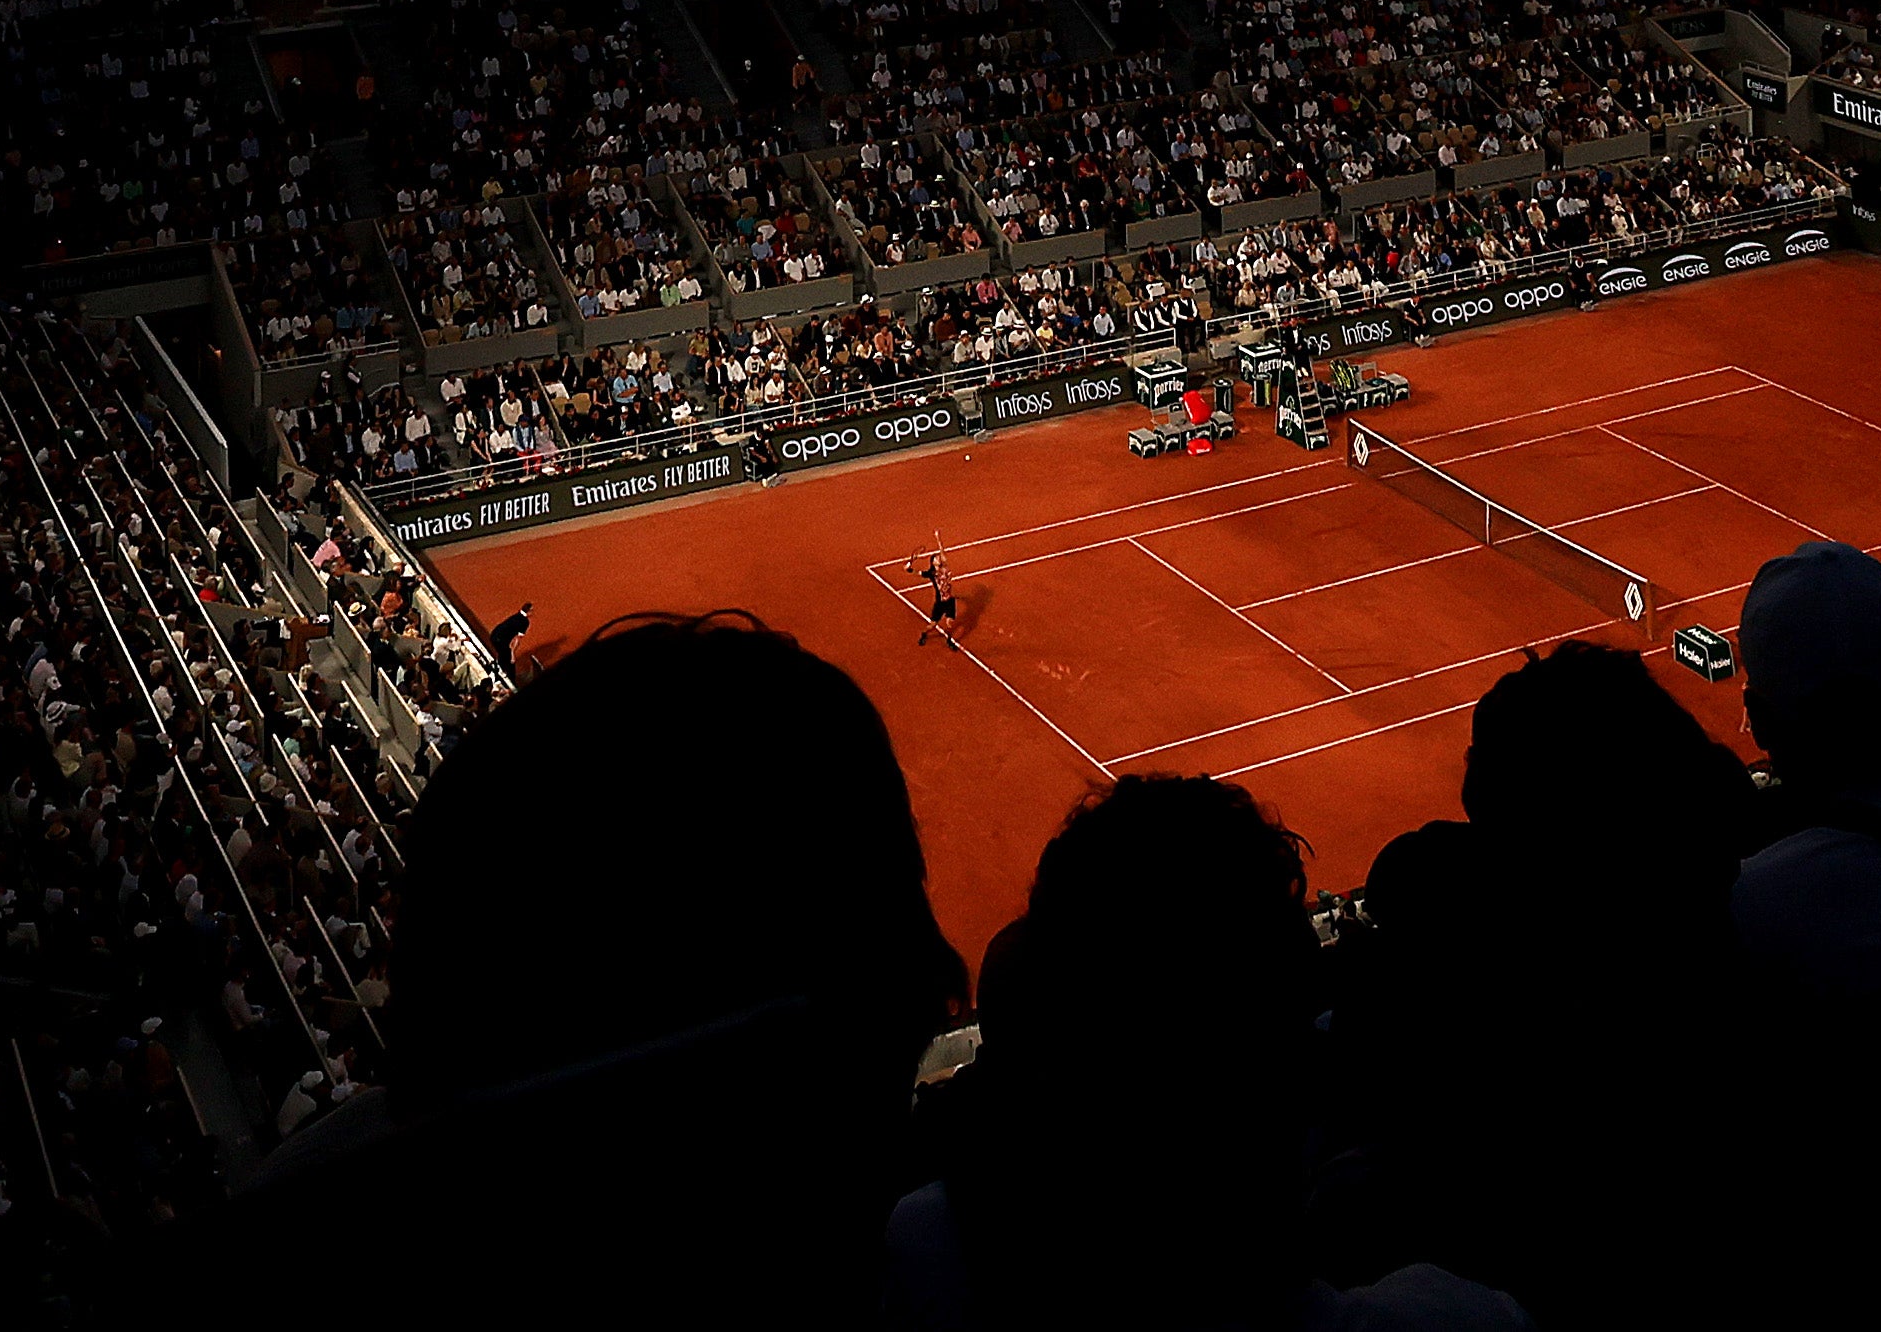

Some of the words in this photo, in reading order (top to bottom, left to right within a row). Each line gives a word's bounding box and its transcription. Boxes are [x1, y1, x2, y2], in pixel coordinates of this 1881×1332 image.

[1431, 296, 1494, 326] oppo
[1504, 281, 1565, 311] oppo
[1340, 318, 1393, 347] Infosys
[994, 389, 1054, 420] Infosys
[1063, 375, 1122, 405] Infosys
[781, 427, 861, 463] oppo
[874, 408, 952, 444] oppo
[571, 472, 658, 508] Emirates
[663, 464, 686, 489] FLY
[686, 453, 731, 485] BETTER
[479, 502, 502, 527] FLY
[504, 491, 550, 522] BETTER
